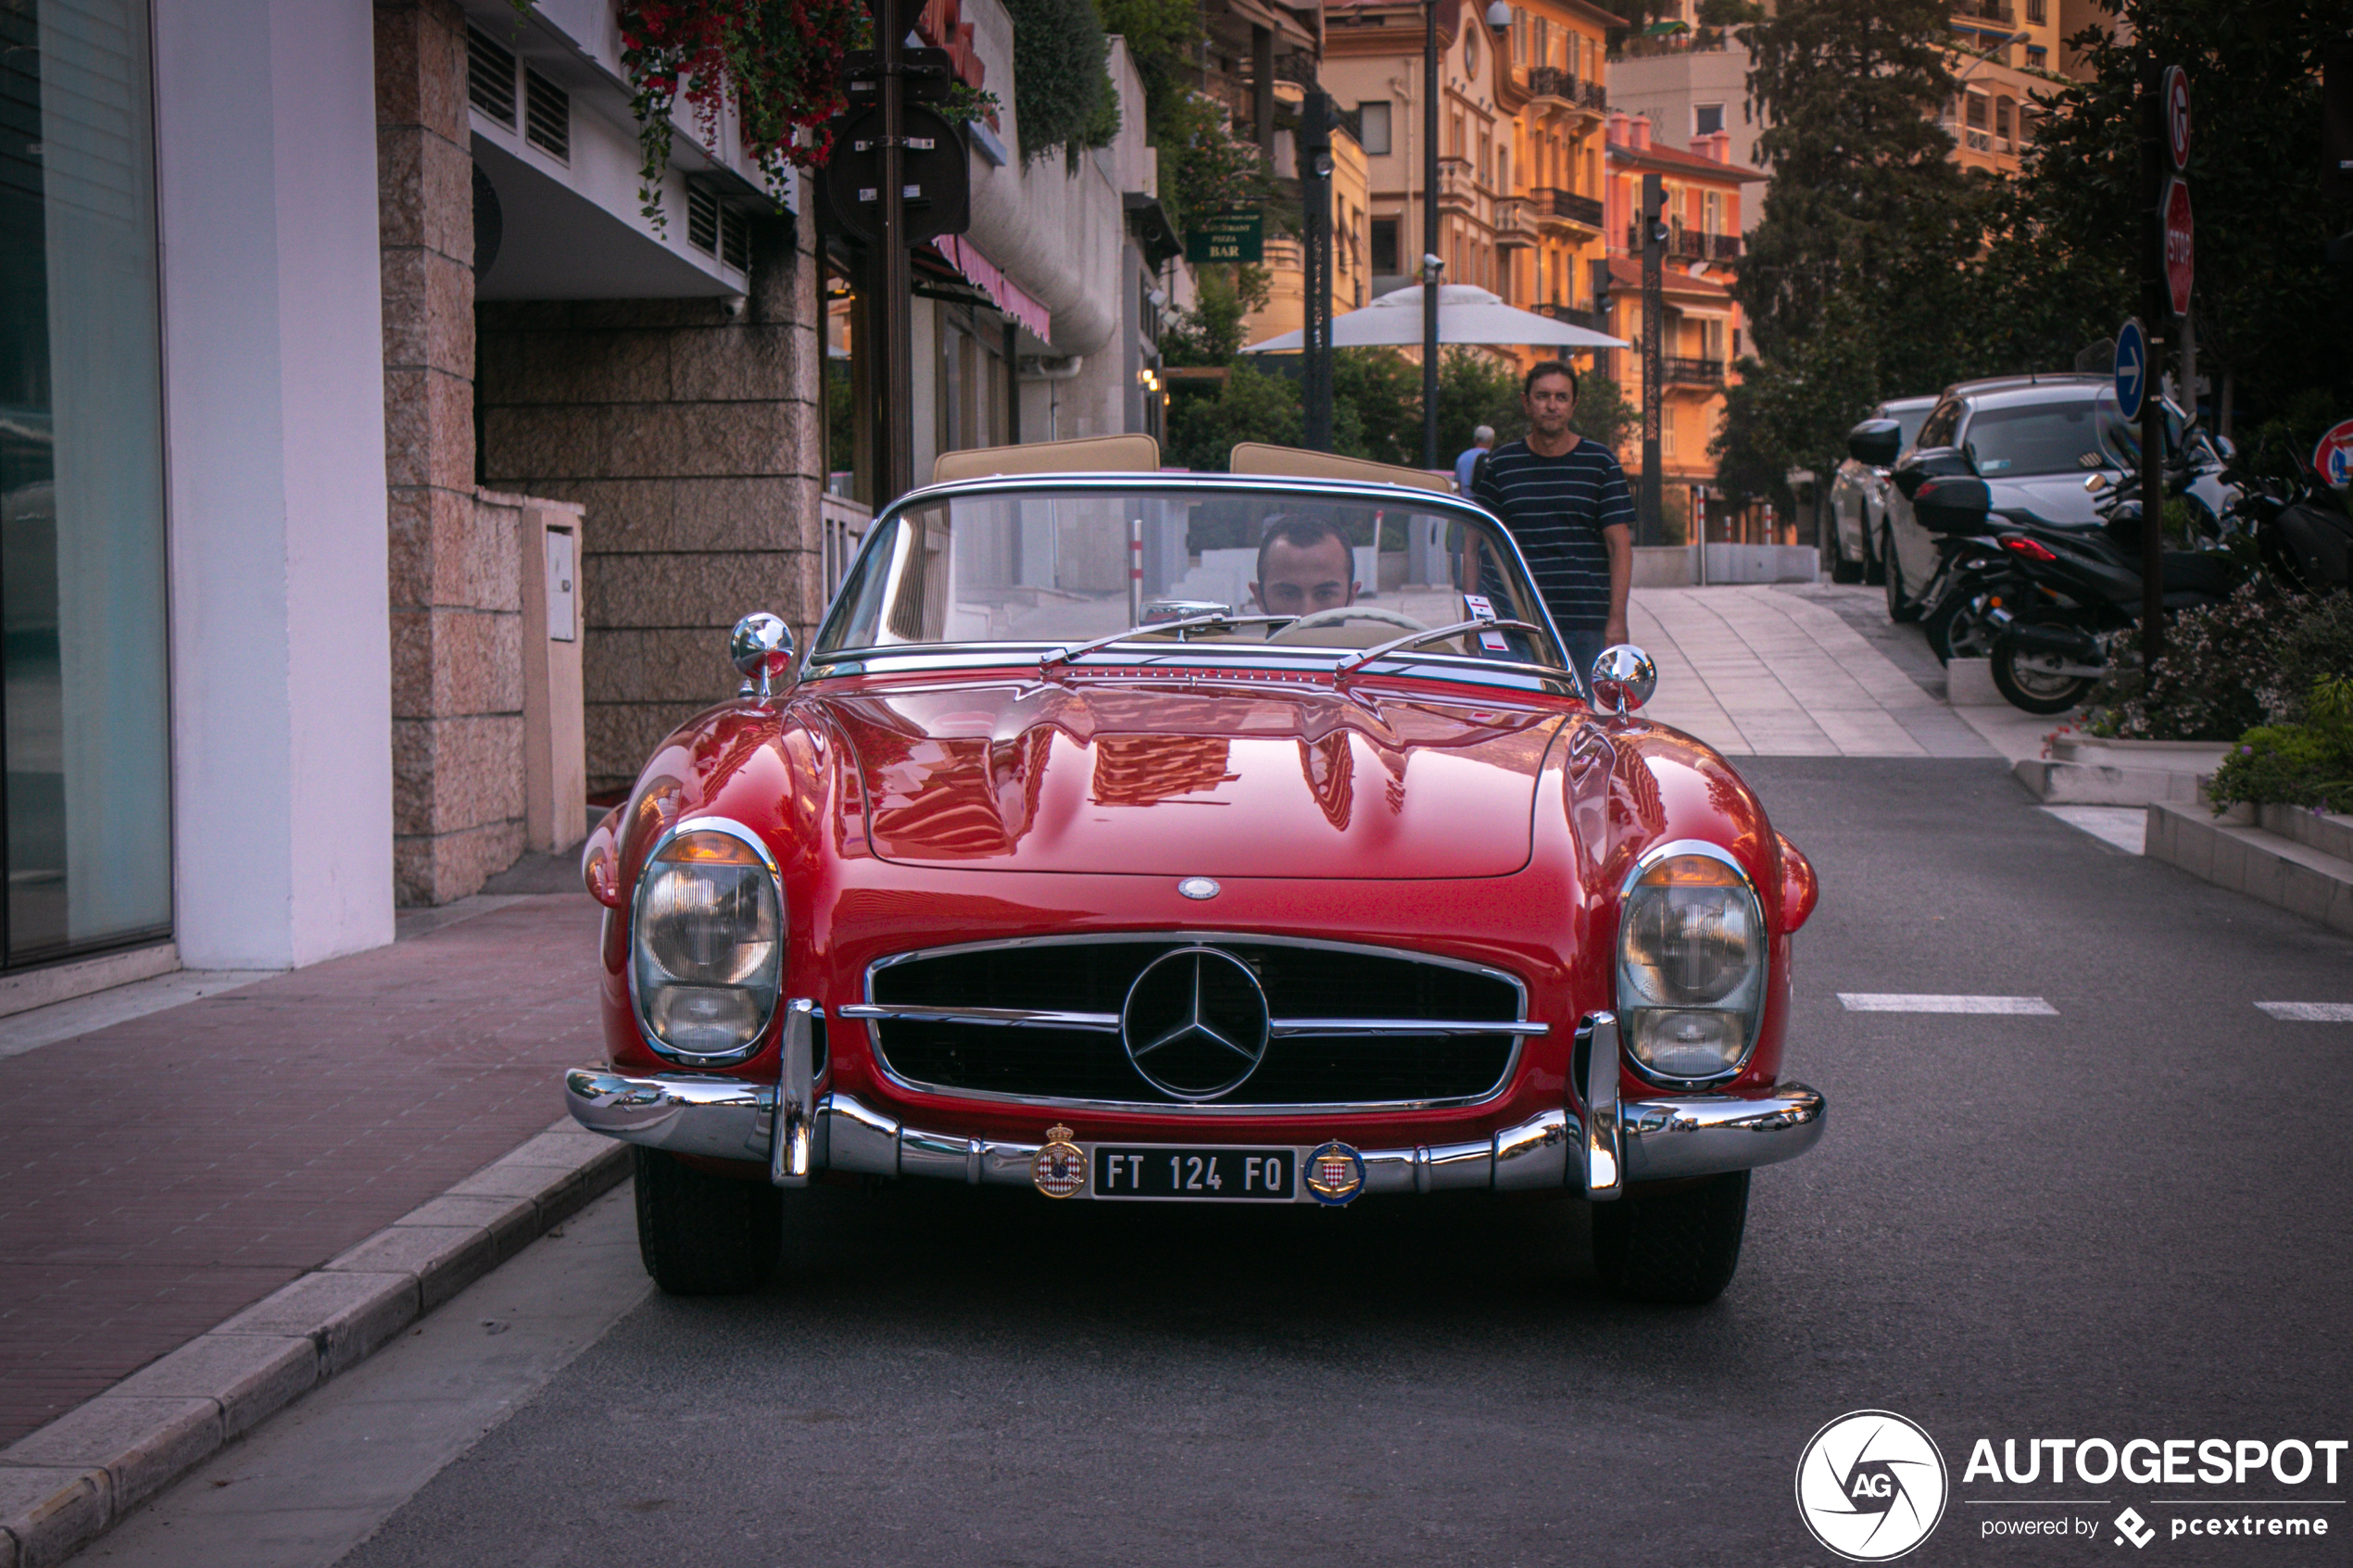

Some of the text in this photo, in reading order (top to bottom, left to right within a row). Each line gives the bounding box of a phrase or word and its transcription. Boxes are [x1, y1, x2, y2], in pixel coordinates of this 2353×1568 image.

[1212, 234, 1237, 243] PIZZA
[2169, 229, 2192, 266] STOP
[1210, 245, 1239, 257] BAR
[1108, 1154, 1281, 1191] FT 124 FQ
